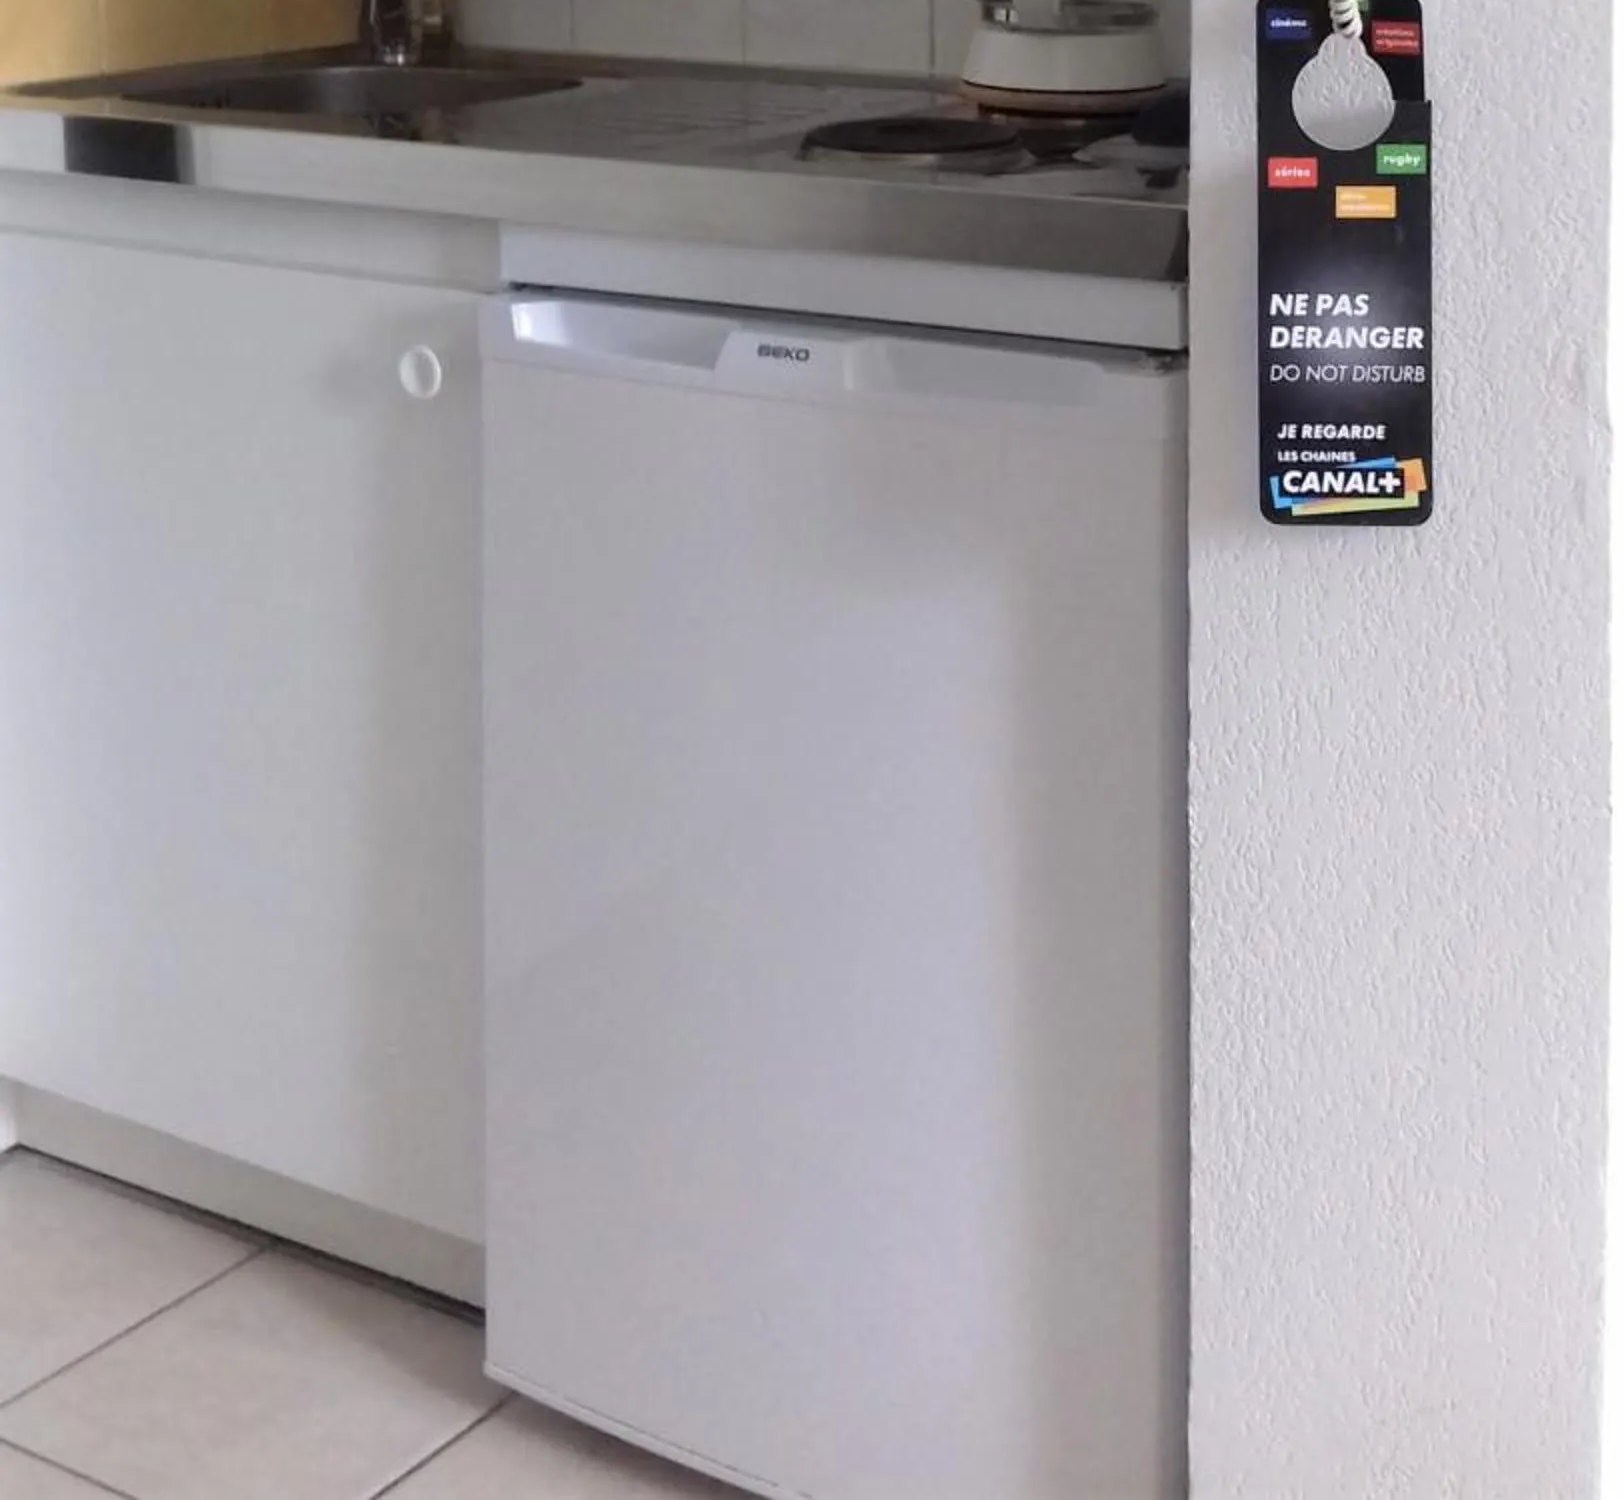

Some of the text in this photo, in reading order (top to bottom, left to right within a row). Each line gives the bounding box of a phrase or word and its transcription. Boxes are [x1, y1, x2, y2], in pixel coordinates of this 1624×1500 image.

[1383, 154, 1421, 167] rugby
[1270, 294, 1369, 316] NE PAS
[757, 344, 810, 361] BEKO
[1270, 365, 1425, 382] DO NOT DISTURB
[1277, 424, 1386, 440] JE REGARDE
[1277, 451, 1298, 462] LES
[1282, 470, 1401, 494] CANAL+
